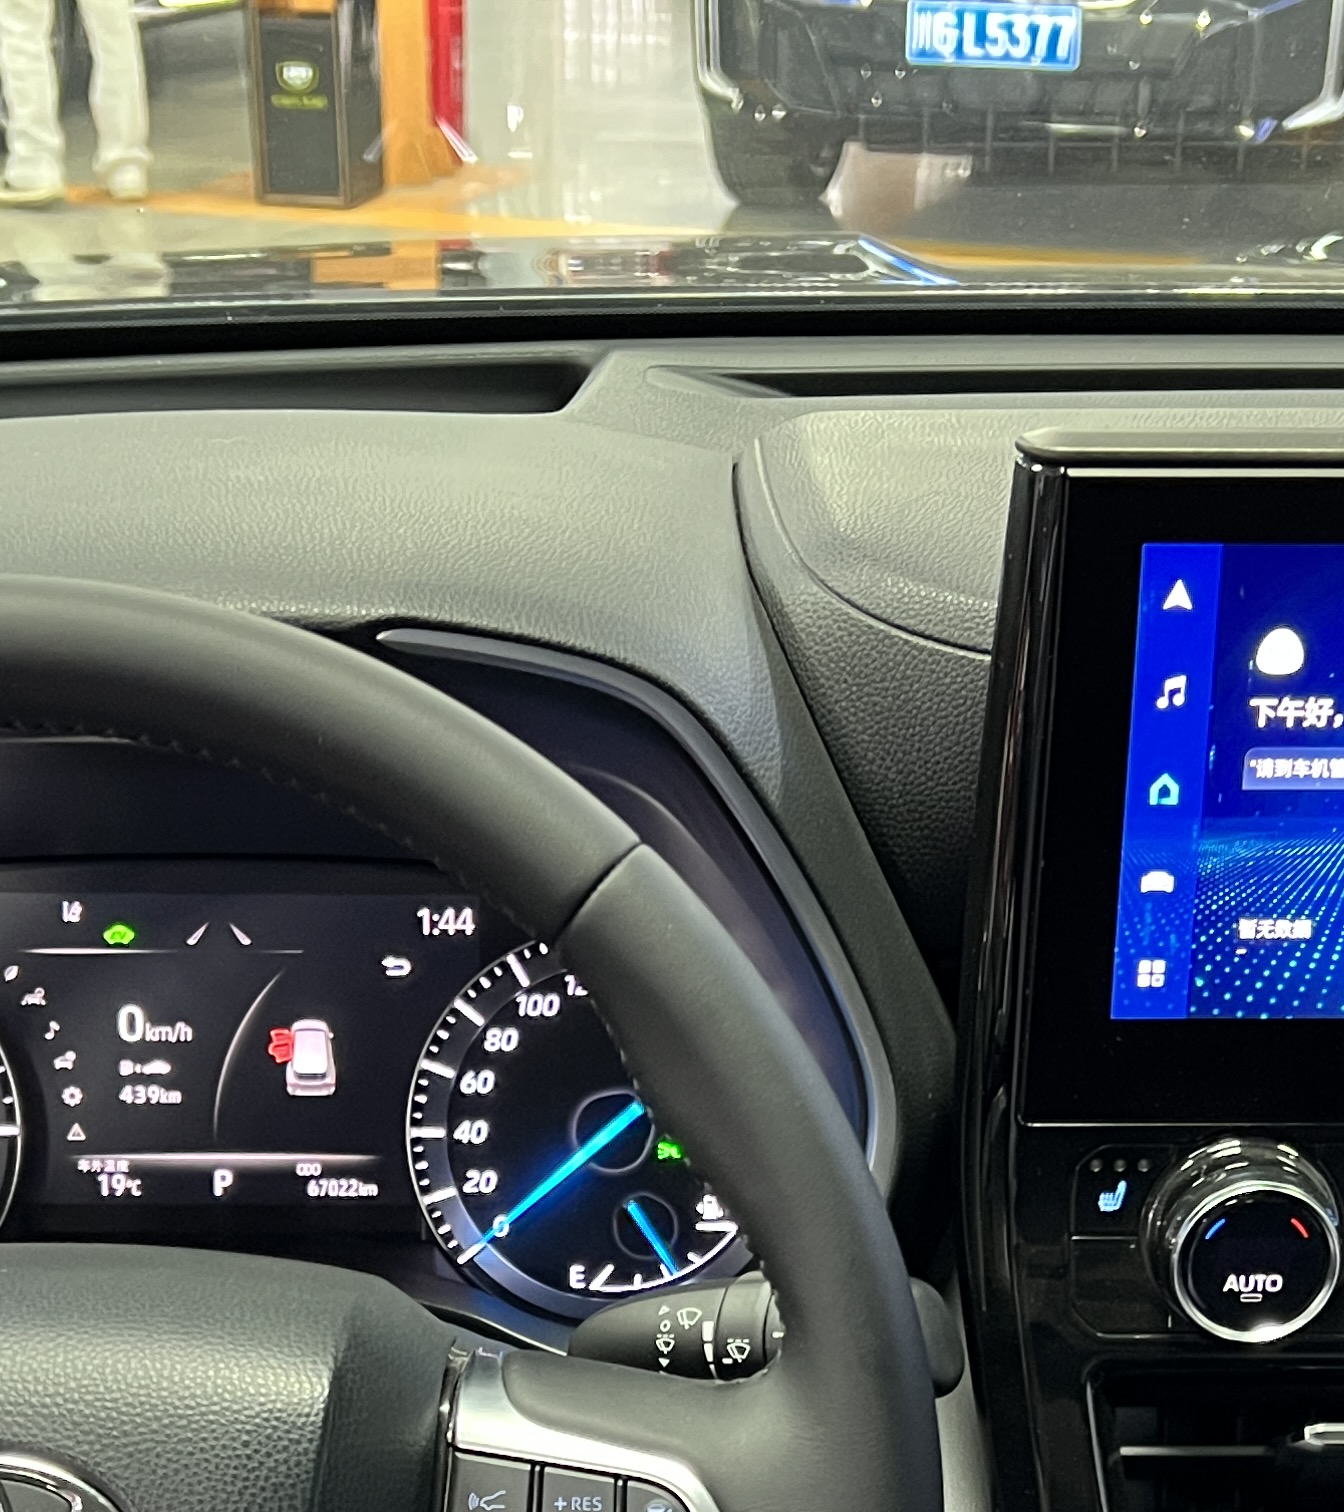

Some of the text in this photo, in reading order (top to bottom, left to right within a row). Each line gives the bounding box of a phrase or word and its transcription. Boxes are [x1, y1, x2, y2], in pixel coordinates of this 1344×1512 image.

[417, 908, 475, 936] 1:44
[516, 994, 560, 1018] 100
[484, 1028, 519, 1053] 80
[459, 1070, 495, 1095] 60
[453, 1120, 489, 1146] 40
[213, 1169, 233, 1196] P
[463, 1169, 498, 1196] 20
[569, 1266, 585, 1289] E
[1223, 1274, 1283, 1293] AUTO
